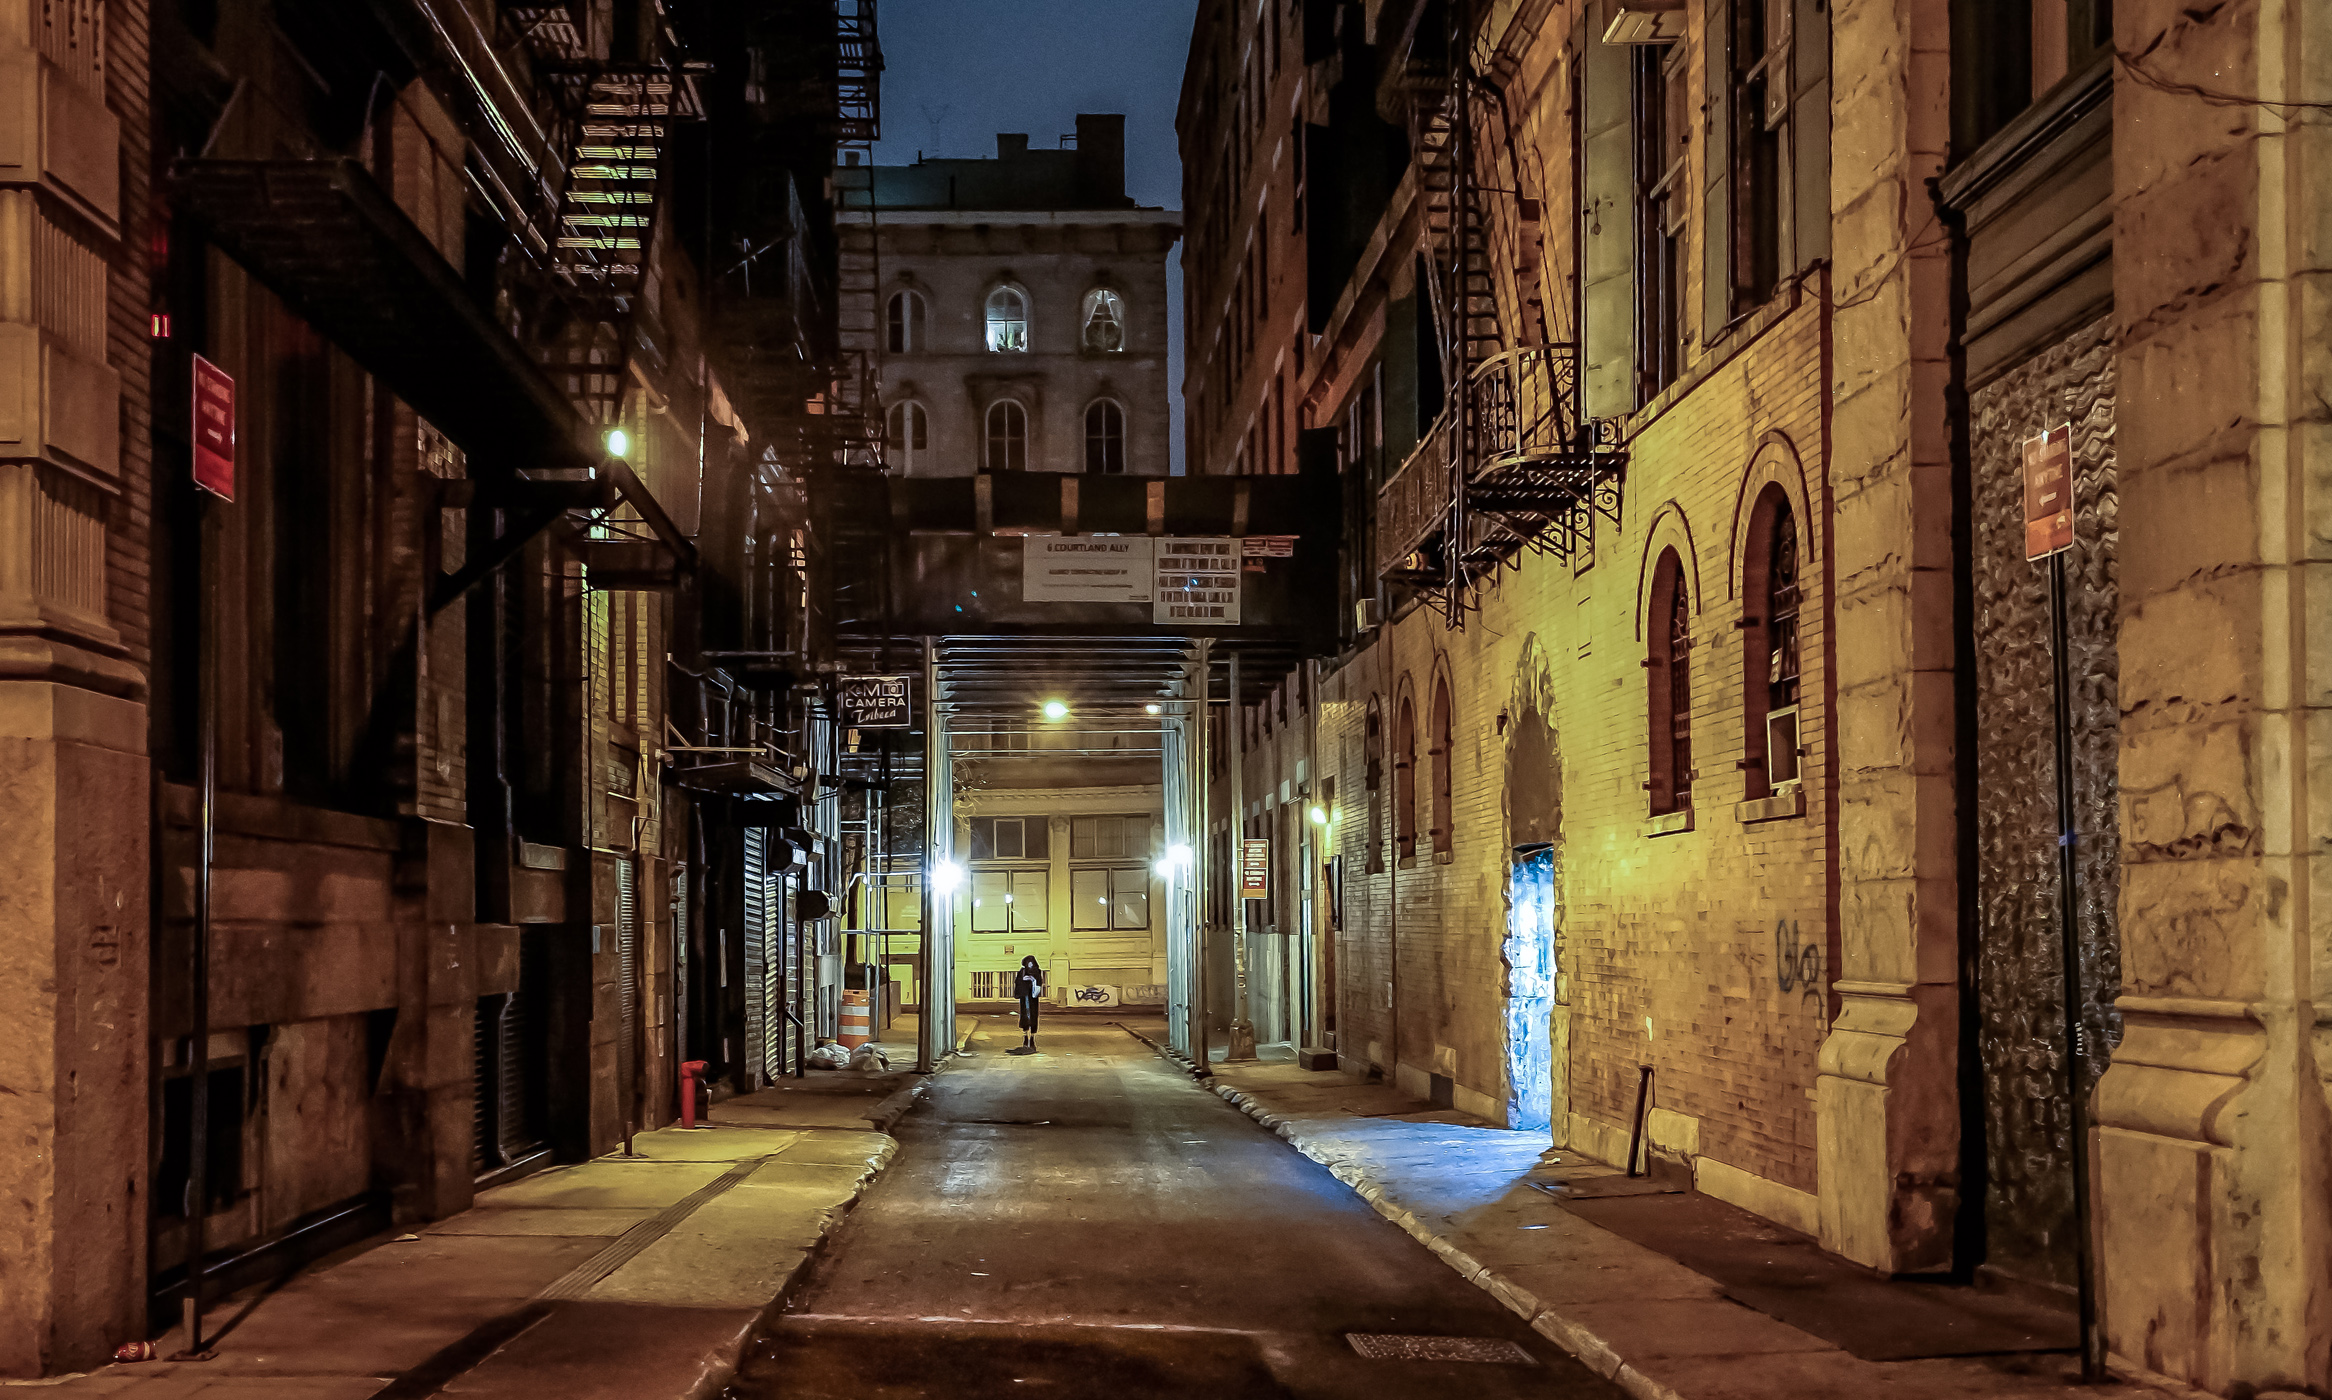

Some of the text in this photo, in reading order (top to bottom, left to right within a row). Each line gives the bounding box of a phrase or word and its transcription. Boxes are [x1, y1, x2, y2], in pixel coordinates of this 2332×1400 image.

[1047, 543, 1130, 553] 6 COURTLAND ALLY
[845, 697, 906, 708] CAMERA
